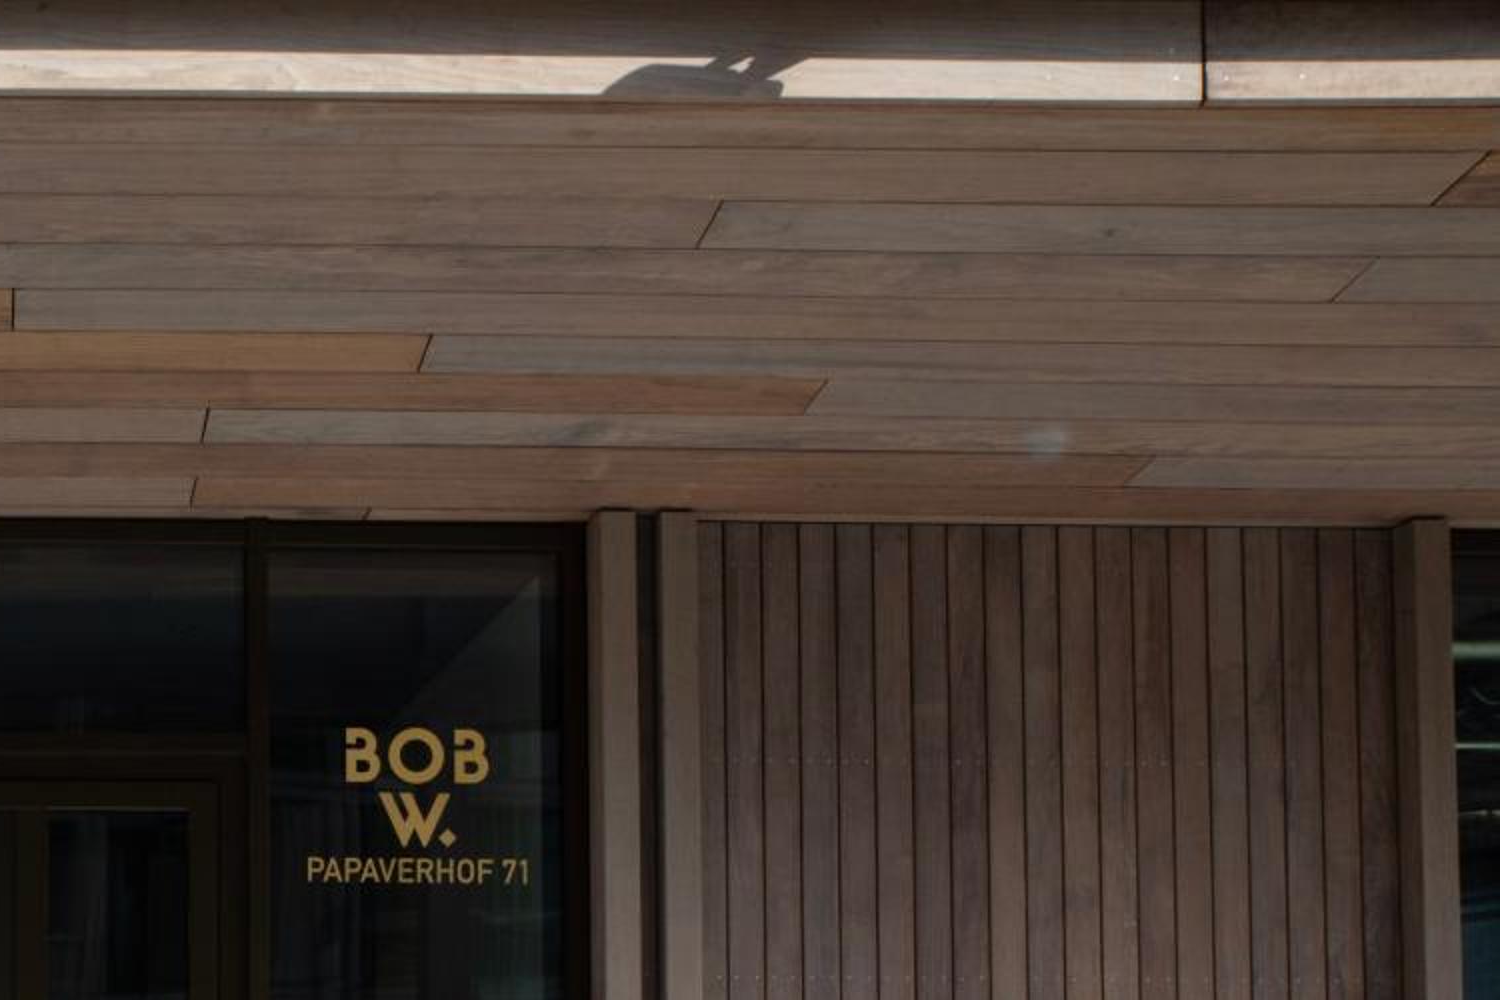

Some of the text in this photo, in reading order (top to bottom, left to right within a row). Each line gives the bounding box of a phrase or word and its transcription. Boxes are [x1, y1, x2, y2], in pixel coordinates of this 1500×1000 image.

[345, 727, 489, 784] BOB
[378, 791, 457, 848] W.
[307, 857, 529, 885] PAPAVERHOF 71
